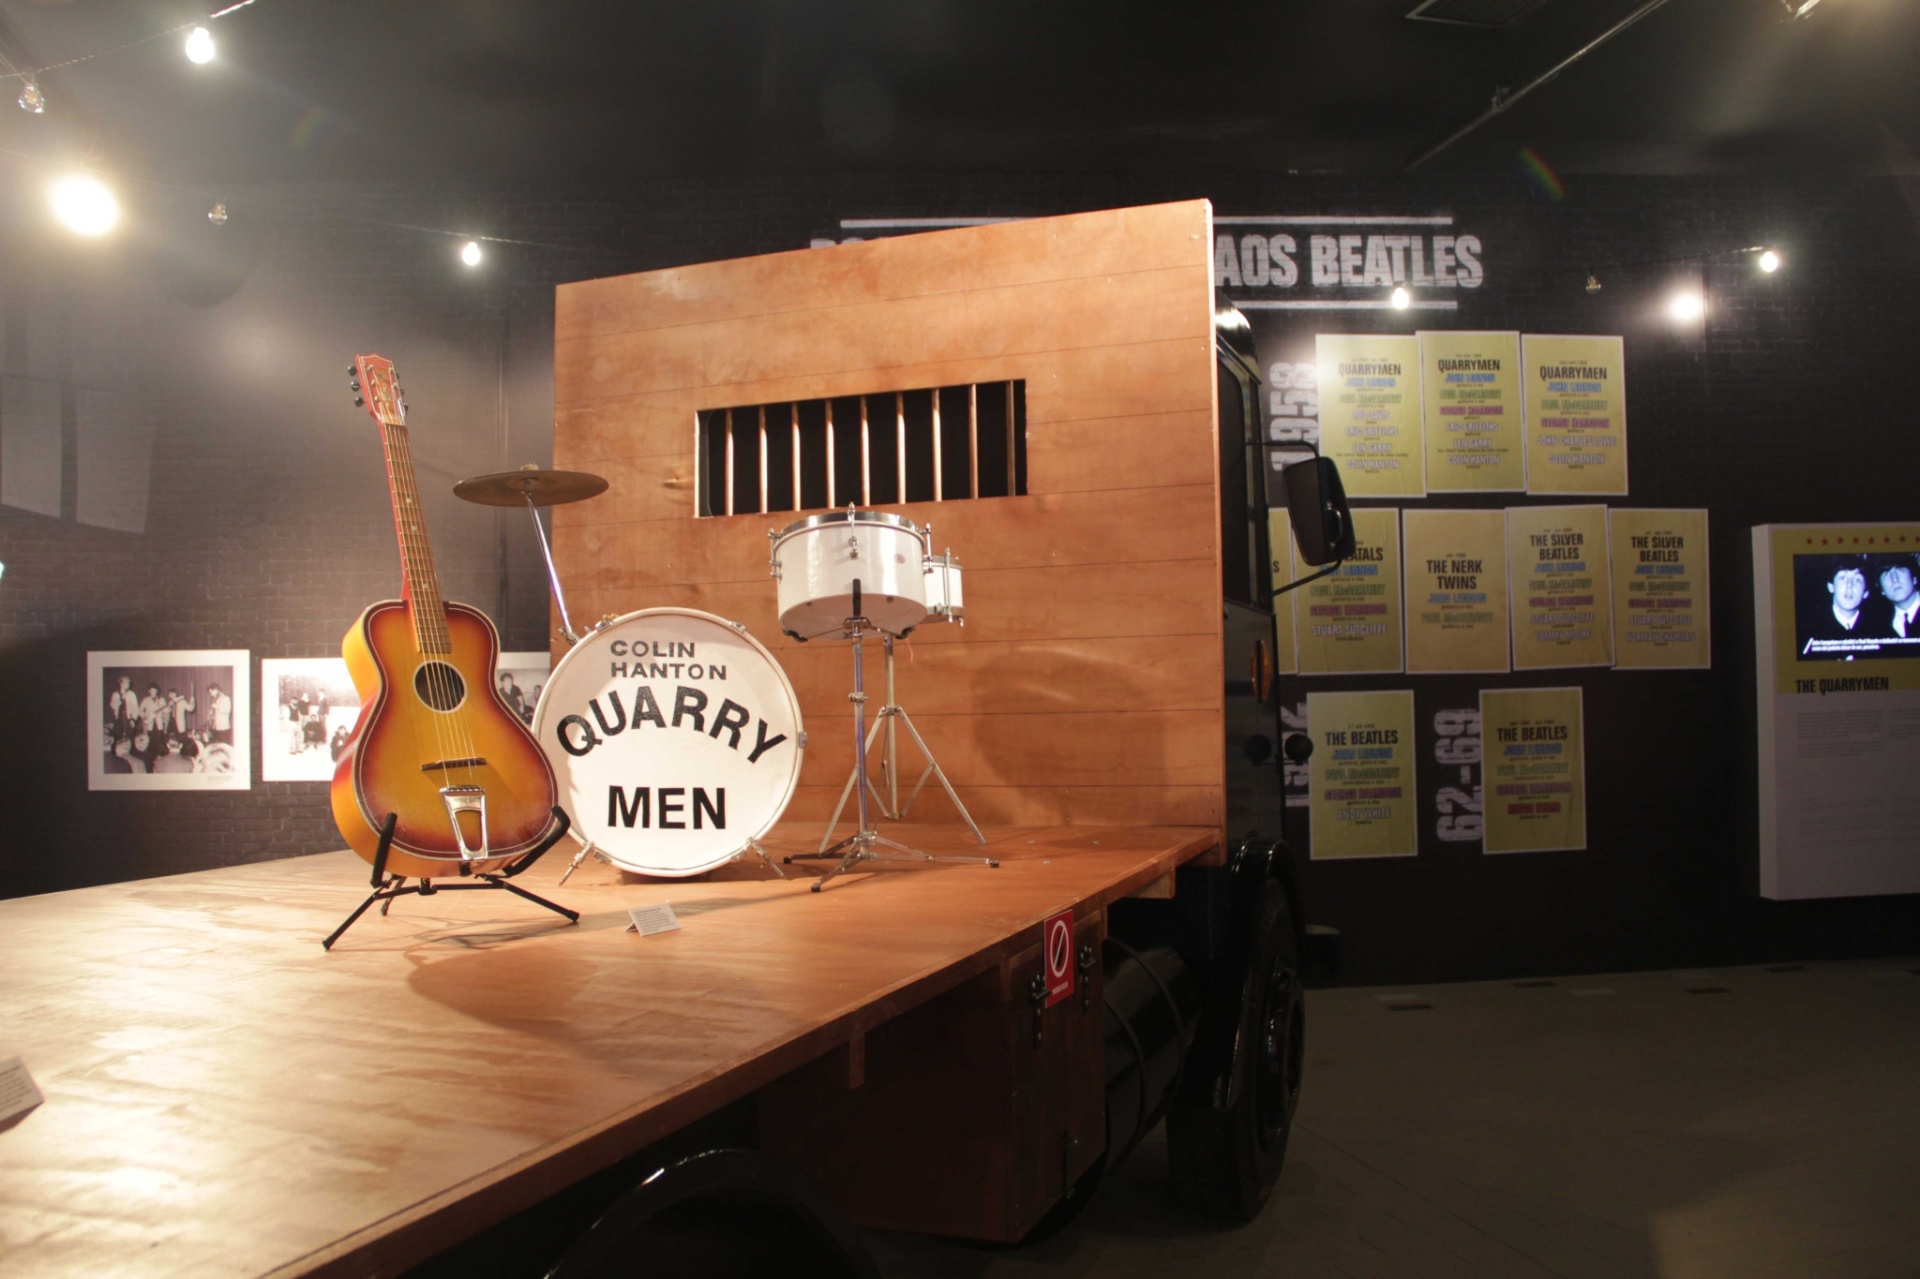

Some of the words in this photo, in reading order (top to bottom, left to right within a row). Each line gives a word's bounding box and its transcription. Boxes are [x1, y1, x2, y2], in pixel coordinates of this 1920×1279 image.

[1215, 234, 1298, 287] AOS
[1310, 234, 1483, 288] BEATLES
[1339, 363, 1402, 377] QUARRYMEN
[1438, 359, 1500, 373] QUARRYMEN
[1540, 366, 1607, 381] QUARRYMEN
[1529, 535, 1548, 546] THE
[1551, 533, 1583, 545] SILVER
[1631, 536, 1648, 548] THE
[1651, 536, 1683, 548] SILVER
[1344, 547, 1383, 562] ATALS
[1539, 547, 1579, 560] BEATLES
[1639, 550, 1679, 562] BEATLES
[1427, 560, 1447, 573] THE
[1451, 560, 1482, 573] NERK
[1437, 575, 1476, 589] TWINS
[610, 640, 695, 658] COLIN
[610, 662, 727, 680] HANTON
[1796, 679, 1816, 693] THE
[1818, 676, 1889, 695] QUARRYMEN
[556, 685, 788, 764] QUARRY
[1325, 732, 1347, 746] THE
[1351, 729, 1398, 745] BEATLES
[1496, 728, 1518, 742] THE
[1522, 725, 1568, 741] BEATLES
[607, 785, 726, 830] MEN
